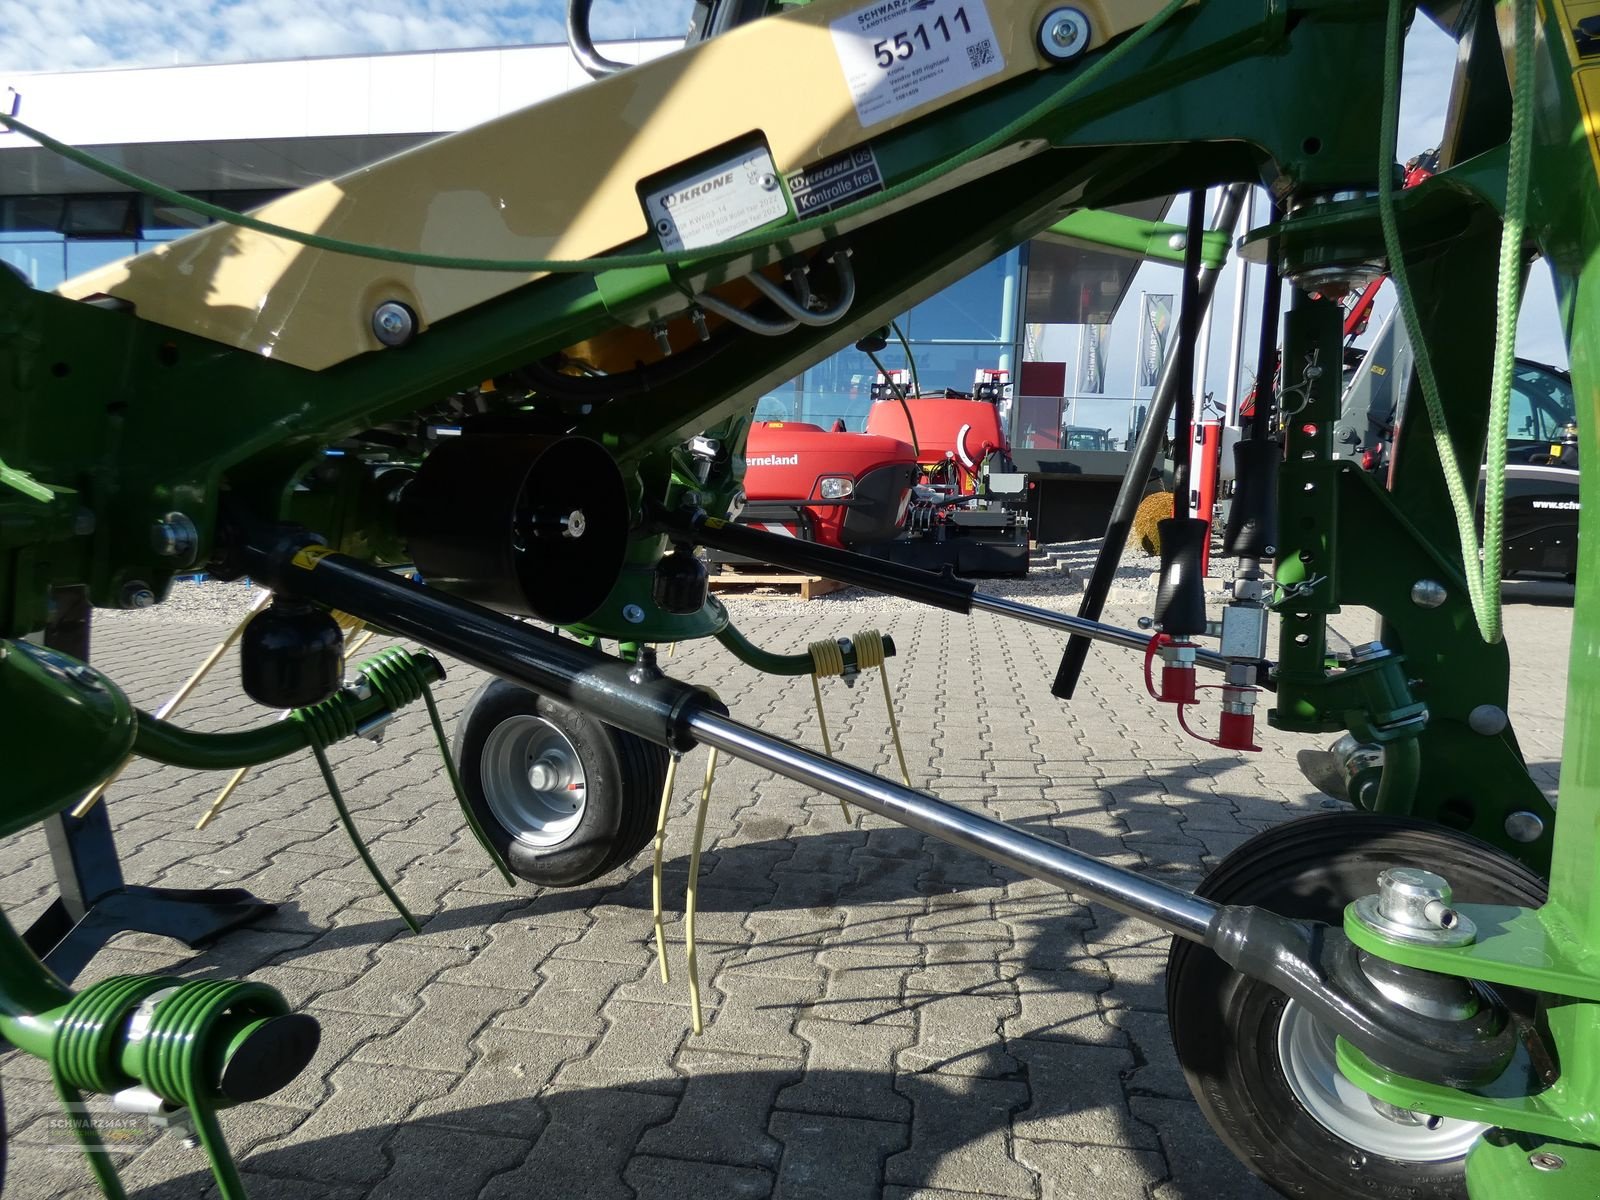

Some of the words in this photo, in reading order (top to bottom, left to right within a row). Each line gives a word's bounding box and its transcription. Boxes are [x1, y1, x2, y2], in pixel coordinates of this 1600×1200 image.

[857, 0, 914, 25] SCHWARZ
[862, 7, 908, 32] LANDTECHNIK
[873, 6, 971, 69] 55111
[805, 159, 851, 186] KRONE
[679, 173, 734, 203] KRONE
[800, 180, 852, 209] Kontrolle
[853, 169, 873, 187] frei
[745, 453, 798, 467] erneland
